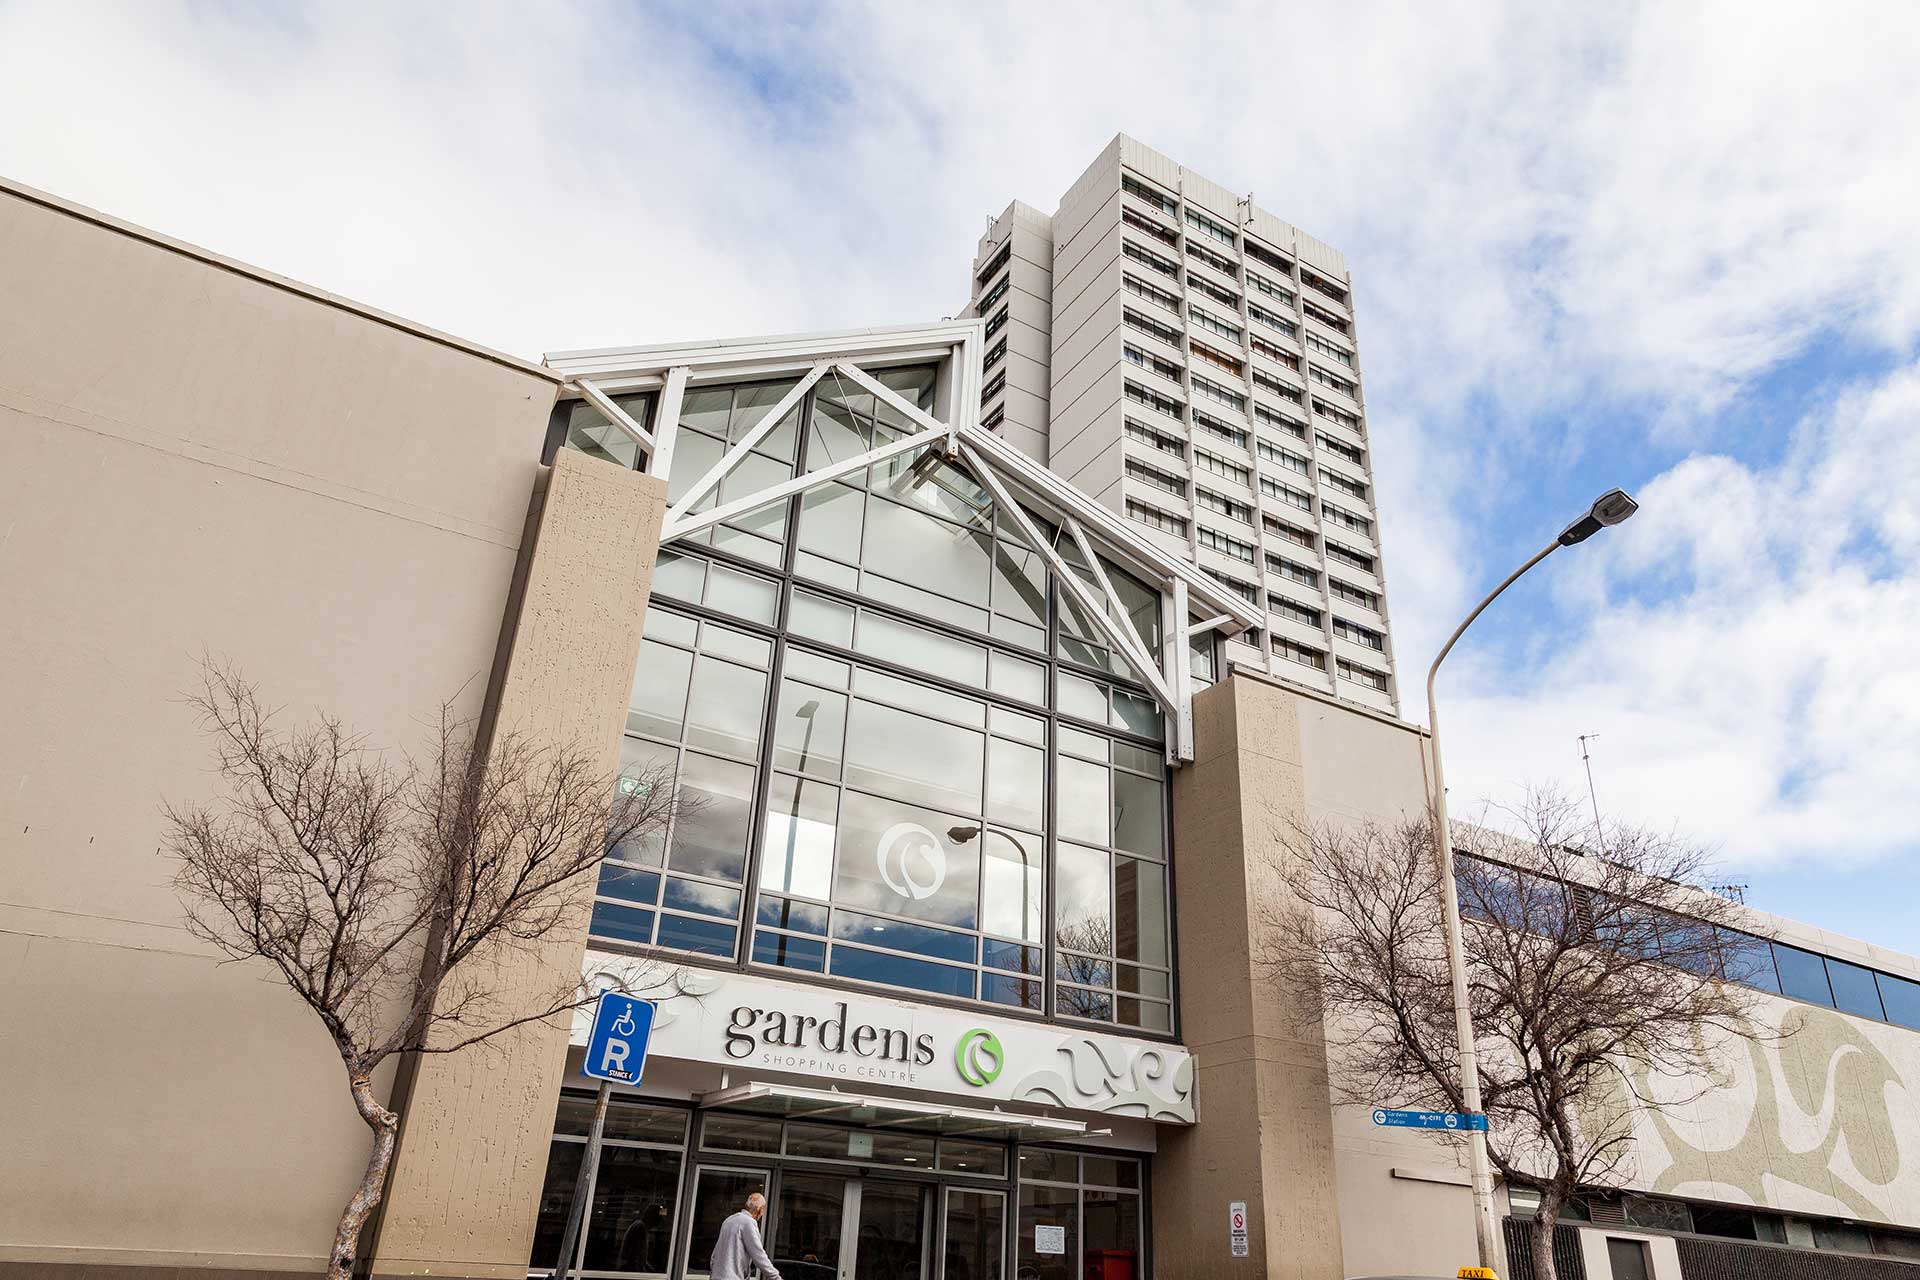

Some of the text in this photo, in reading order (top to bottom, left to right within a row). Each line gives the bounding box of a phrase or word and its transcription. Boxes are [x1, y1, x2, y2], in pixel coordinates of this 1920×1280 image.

[725, 1002, 935, 1066] gardens
[601, 1037, 631, 1071] R
[763, 1054, 917, 1082] SHOPPING CENTRE
[1461, 1269, 1484, 1278] TAXI
